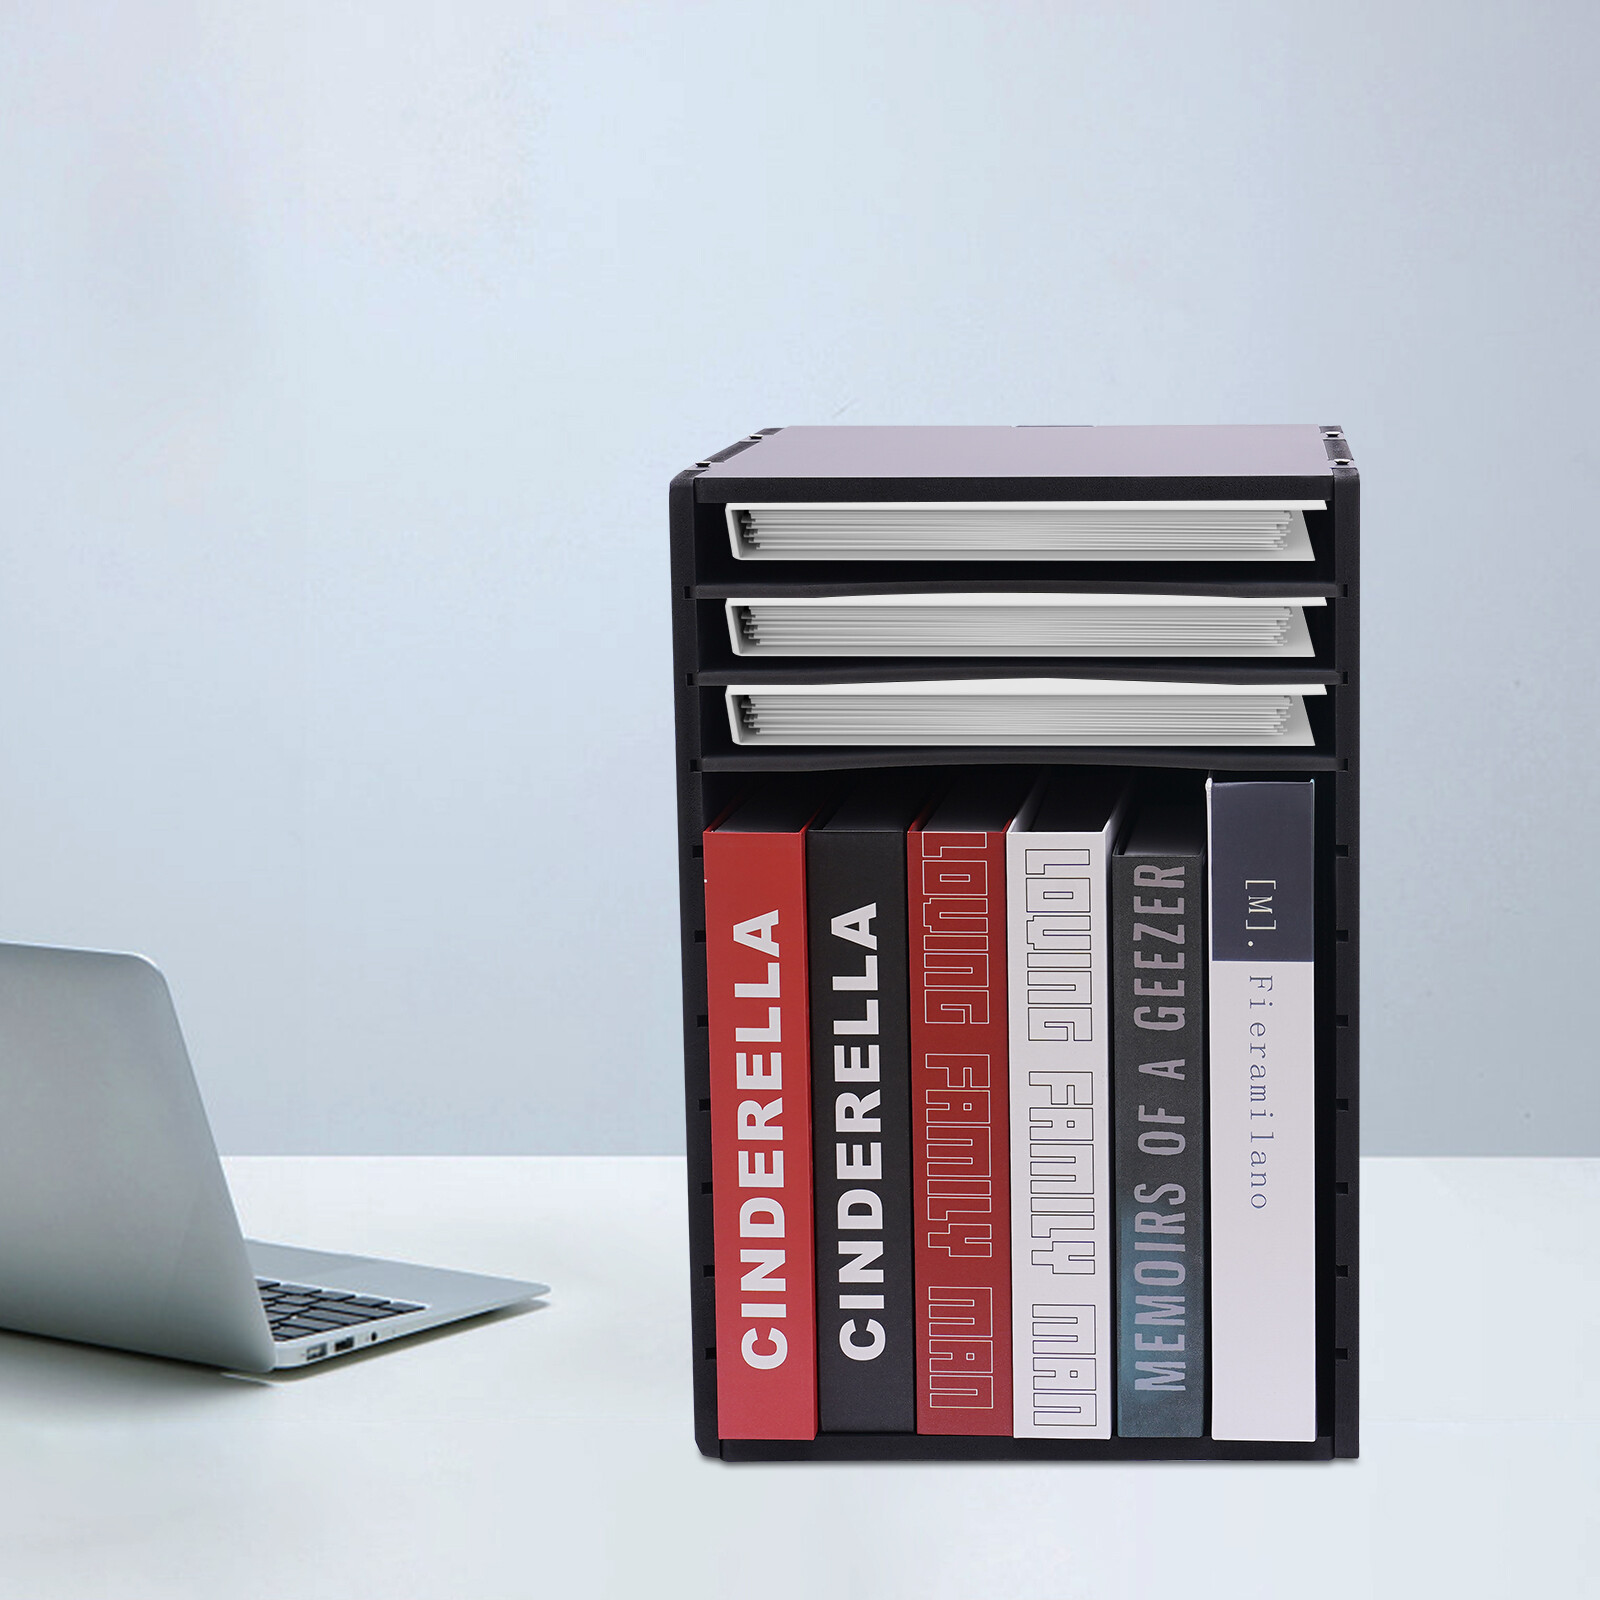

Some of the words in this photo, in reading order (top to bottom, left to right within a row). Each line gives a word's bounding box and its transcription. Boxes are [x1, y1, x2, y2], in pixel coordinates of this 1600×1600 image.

[1133, 862, 1186, 1031] GEEZER
[733, 909, 788, 1370] CINDERELLA
[831, 903, 886, 1361] CINDERELLA
[925, 1053, 992, 1257] FAMILY
[1138, 1058, 1186, 1082] A
[1138, 1104, 1187, 1156] OF
[1248, 975, 1273, 1211] Fieramilano
[1028, 1071, 1096, 1274] FAMILY
[929, 1286, 994, 1409] MAN
[1032, 1303, 1100, 1426] MAN
[1135, 1183, 1187, 1392] MEMOIRS
